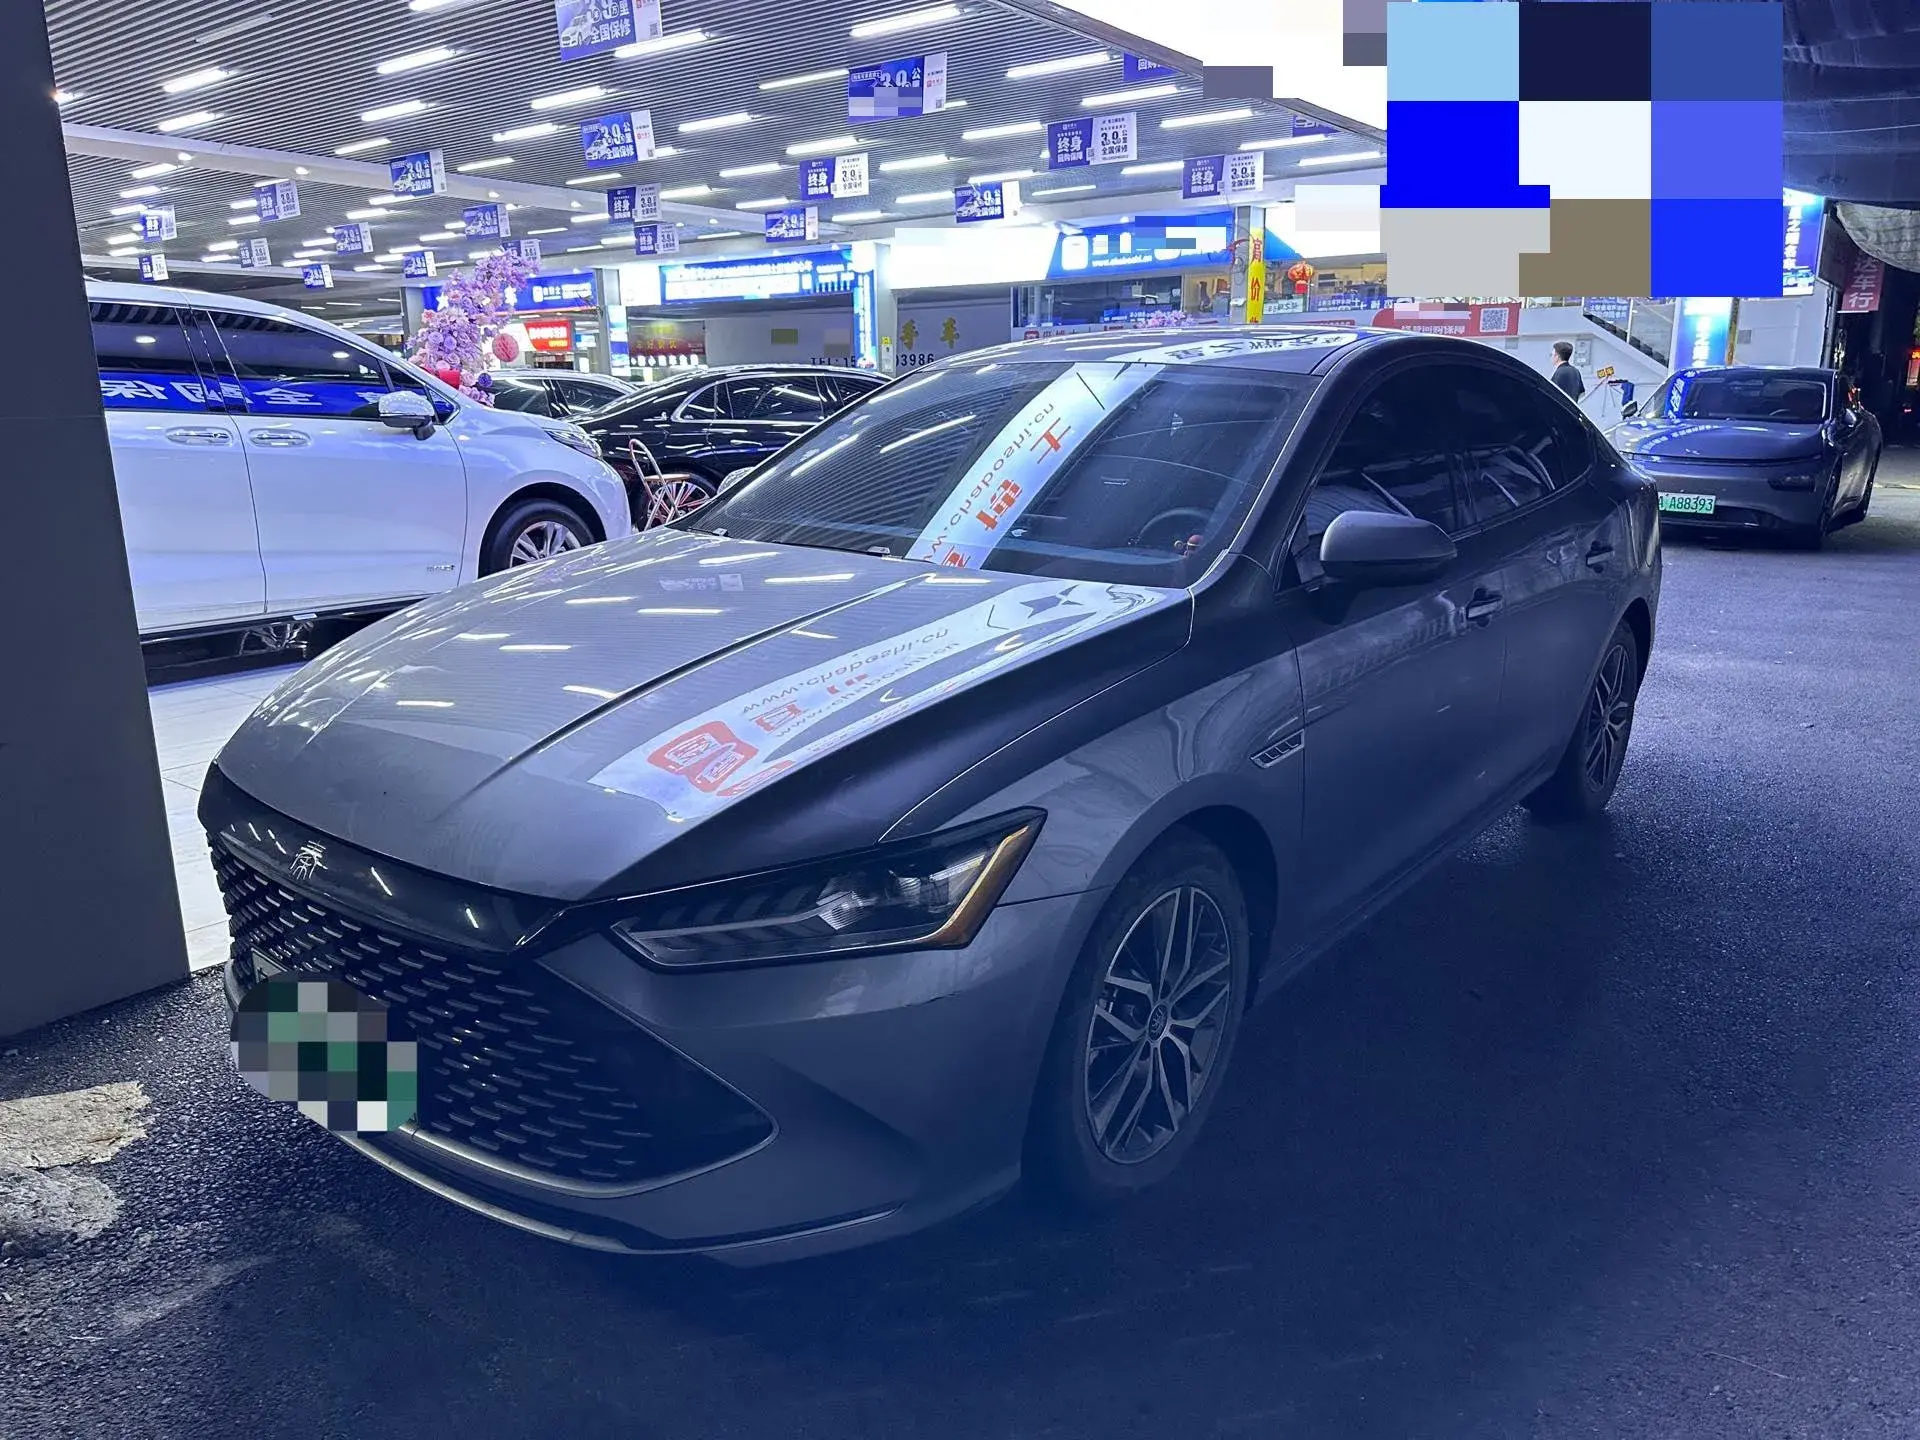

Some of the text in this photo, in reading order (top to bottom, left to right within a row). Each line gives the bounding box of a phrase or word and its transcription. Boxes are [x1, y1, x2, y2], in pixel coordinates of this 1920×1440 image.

[590, 19, 631, 44] 全国保修
[1057, 136, 1082, 153] 终身
[1102, 144, 1128, 156] 全国保修
[1191, 170, 1214, 185] 终身
[1249, 237, 1263, 324] 高价
